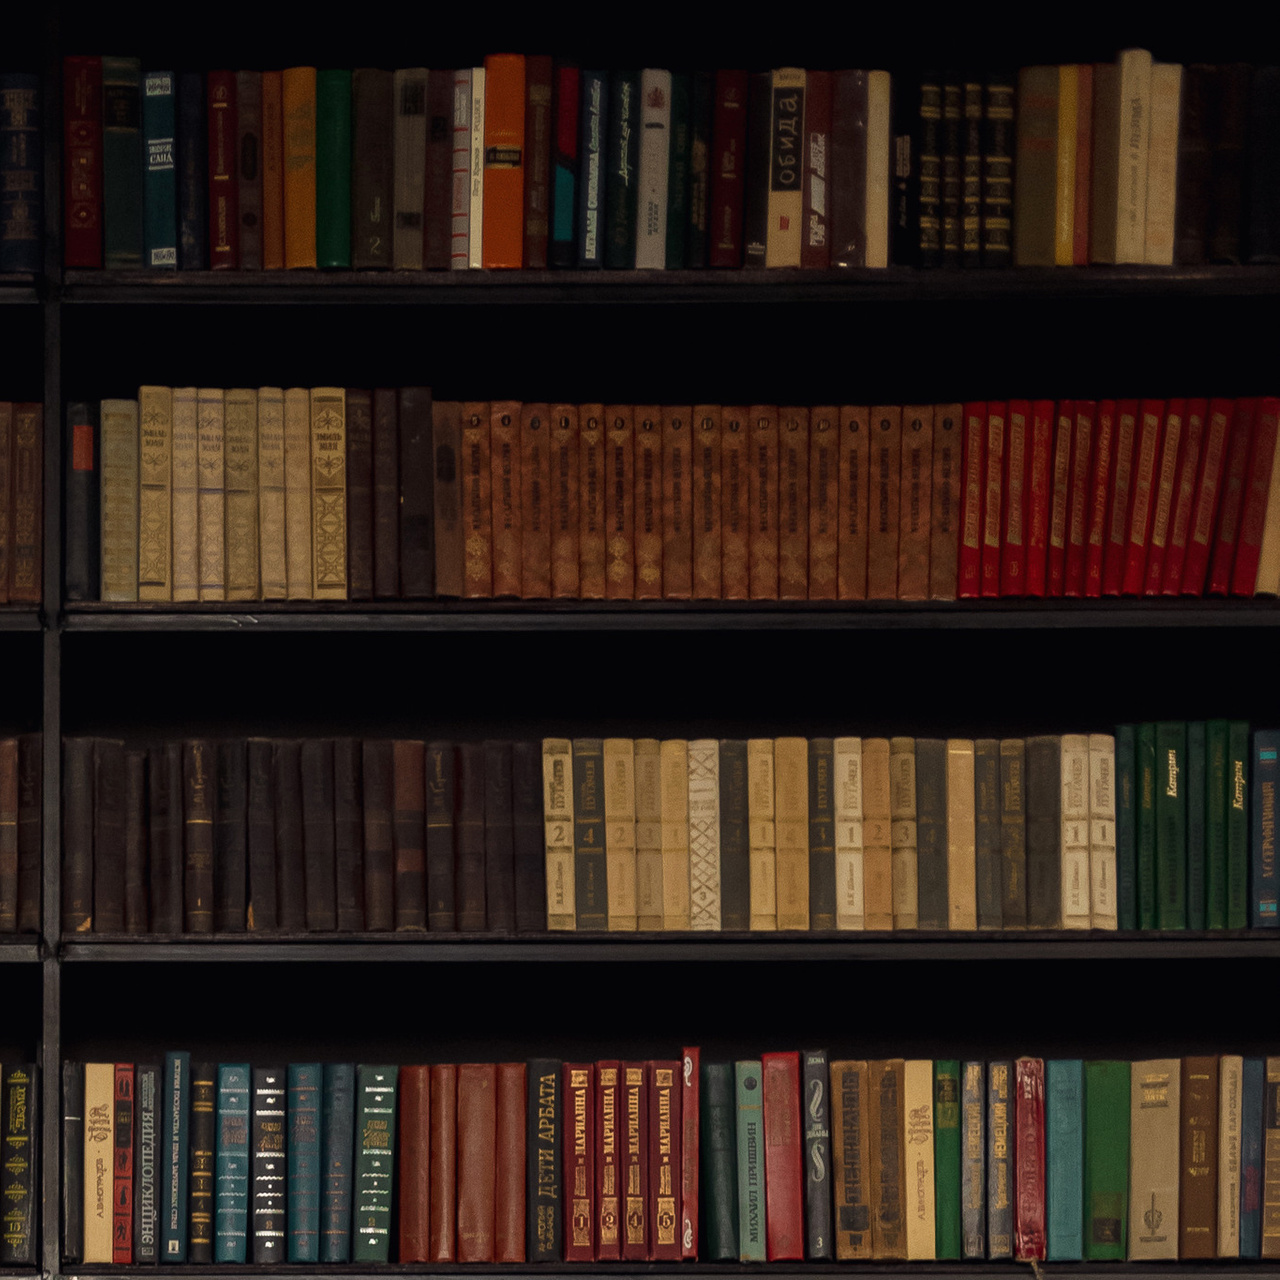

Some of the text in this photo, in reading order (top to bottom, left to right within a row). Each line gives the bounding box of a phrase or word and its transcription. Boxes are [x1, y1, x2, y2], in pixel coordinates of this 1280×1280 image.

[777, 94, 800, 184] ОБИДА
[140, 1110, 156, 1244] ЭНЦИКЛОПЕДИЯ
[538, 1073, 557, 1199] ДЕТИ АРБАТА
[746, 1121, 760, 1243] МИХАИЛ ПРИШВИН
[815, 1235, 824, 1251] 3
